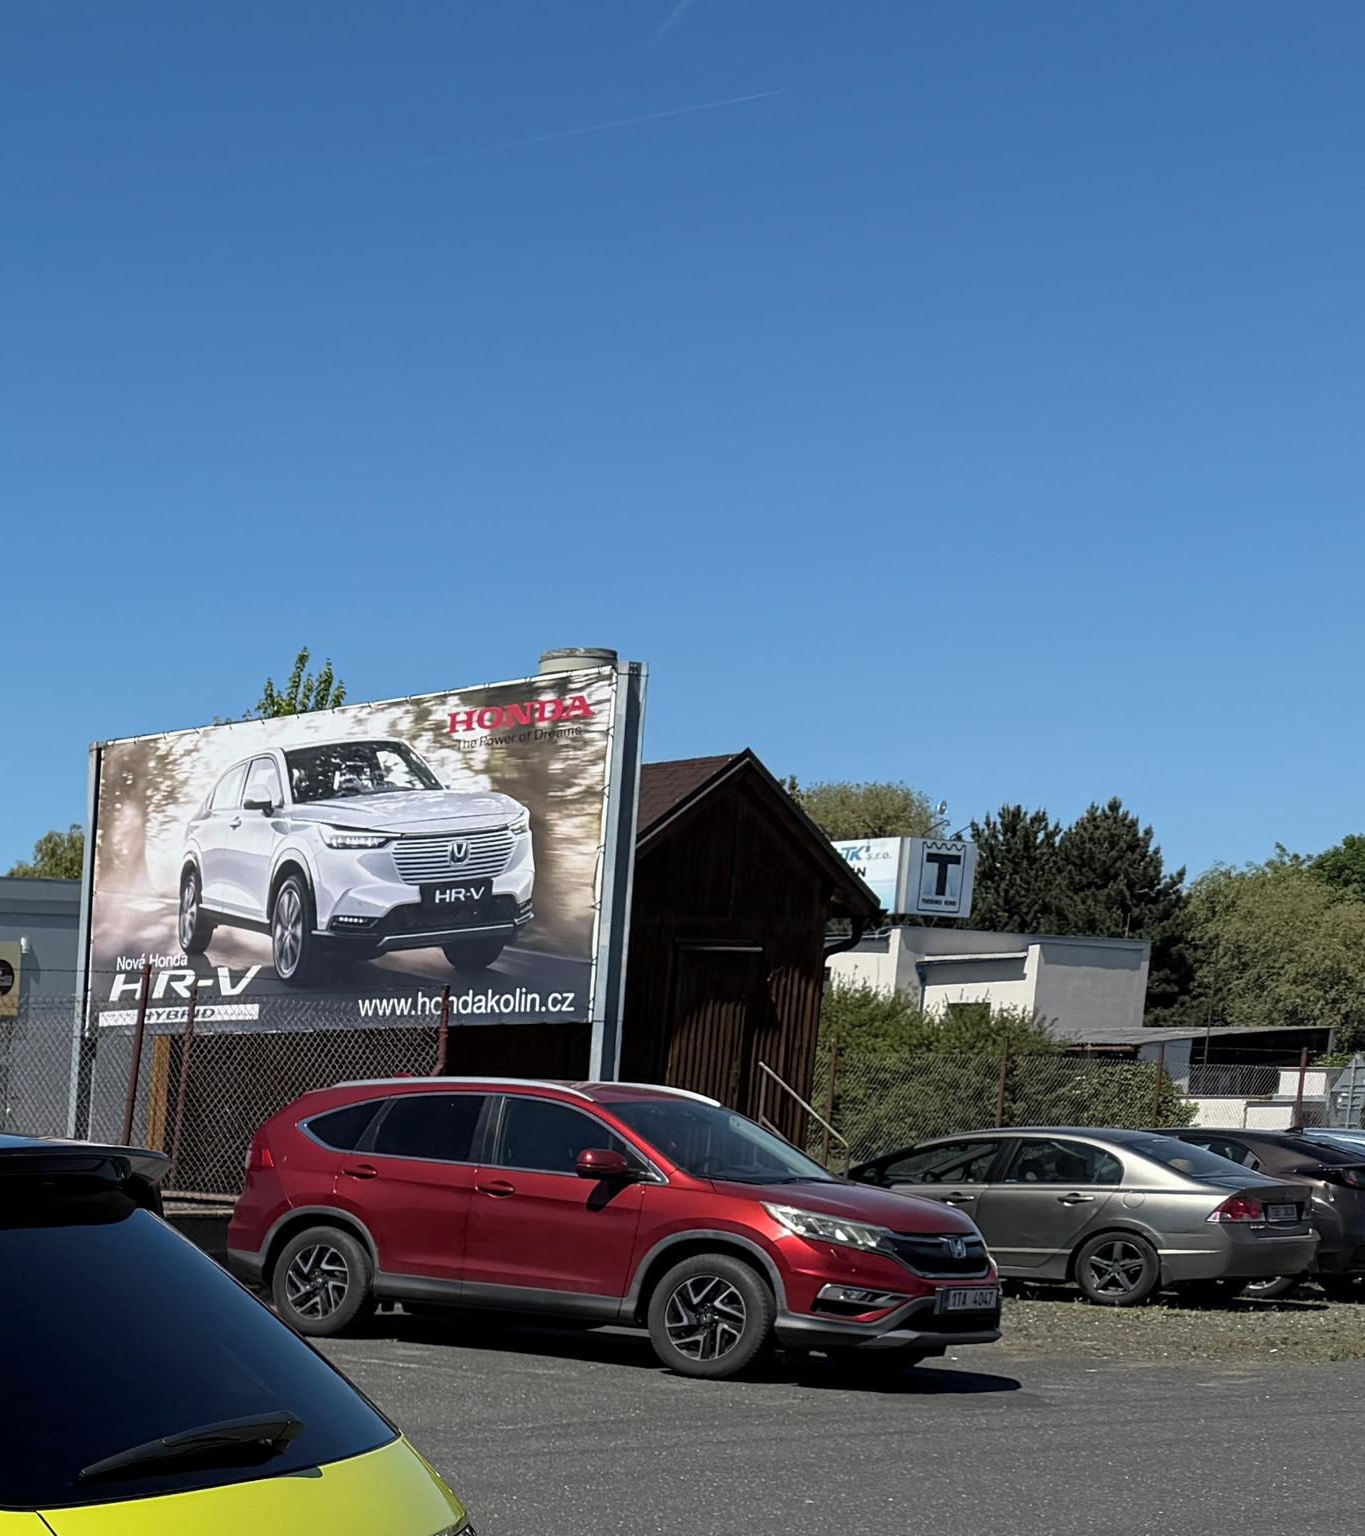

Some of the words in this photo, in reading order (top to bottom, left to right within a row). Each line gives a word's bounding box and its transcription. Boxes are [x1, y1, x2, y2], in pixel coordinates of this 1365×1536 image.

[447, 694, 597, 734] HONDA
[456, 739, 476, 750] The
[479, 735, 515, 747] Power
[519, 731, 530, 742] of
[534, 726, 582, 741] Dreams
[434, 886, 485, 903] HR-V
[116, 953, 146, 971] Nová
[149, 953, 188, 968] Honda
[109, 965, 262, 1001] HR-V
[358, 988, 575, 1016] www.hondakolin.cz
